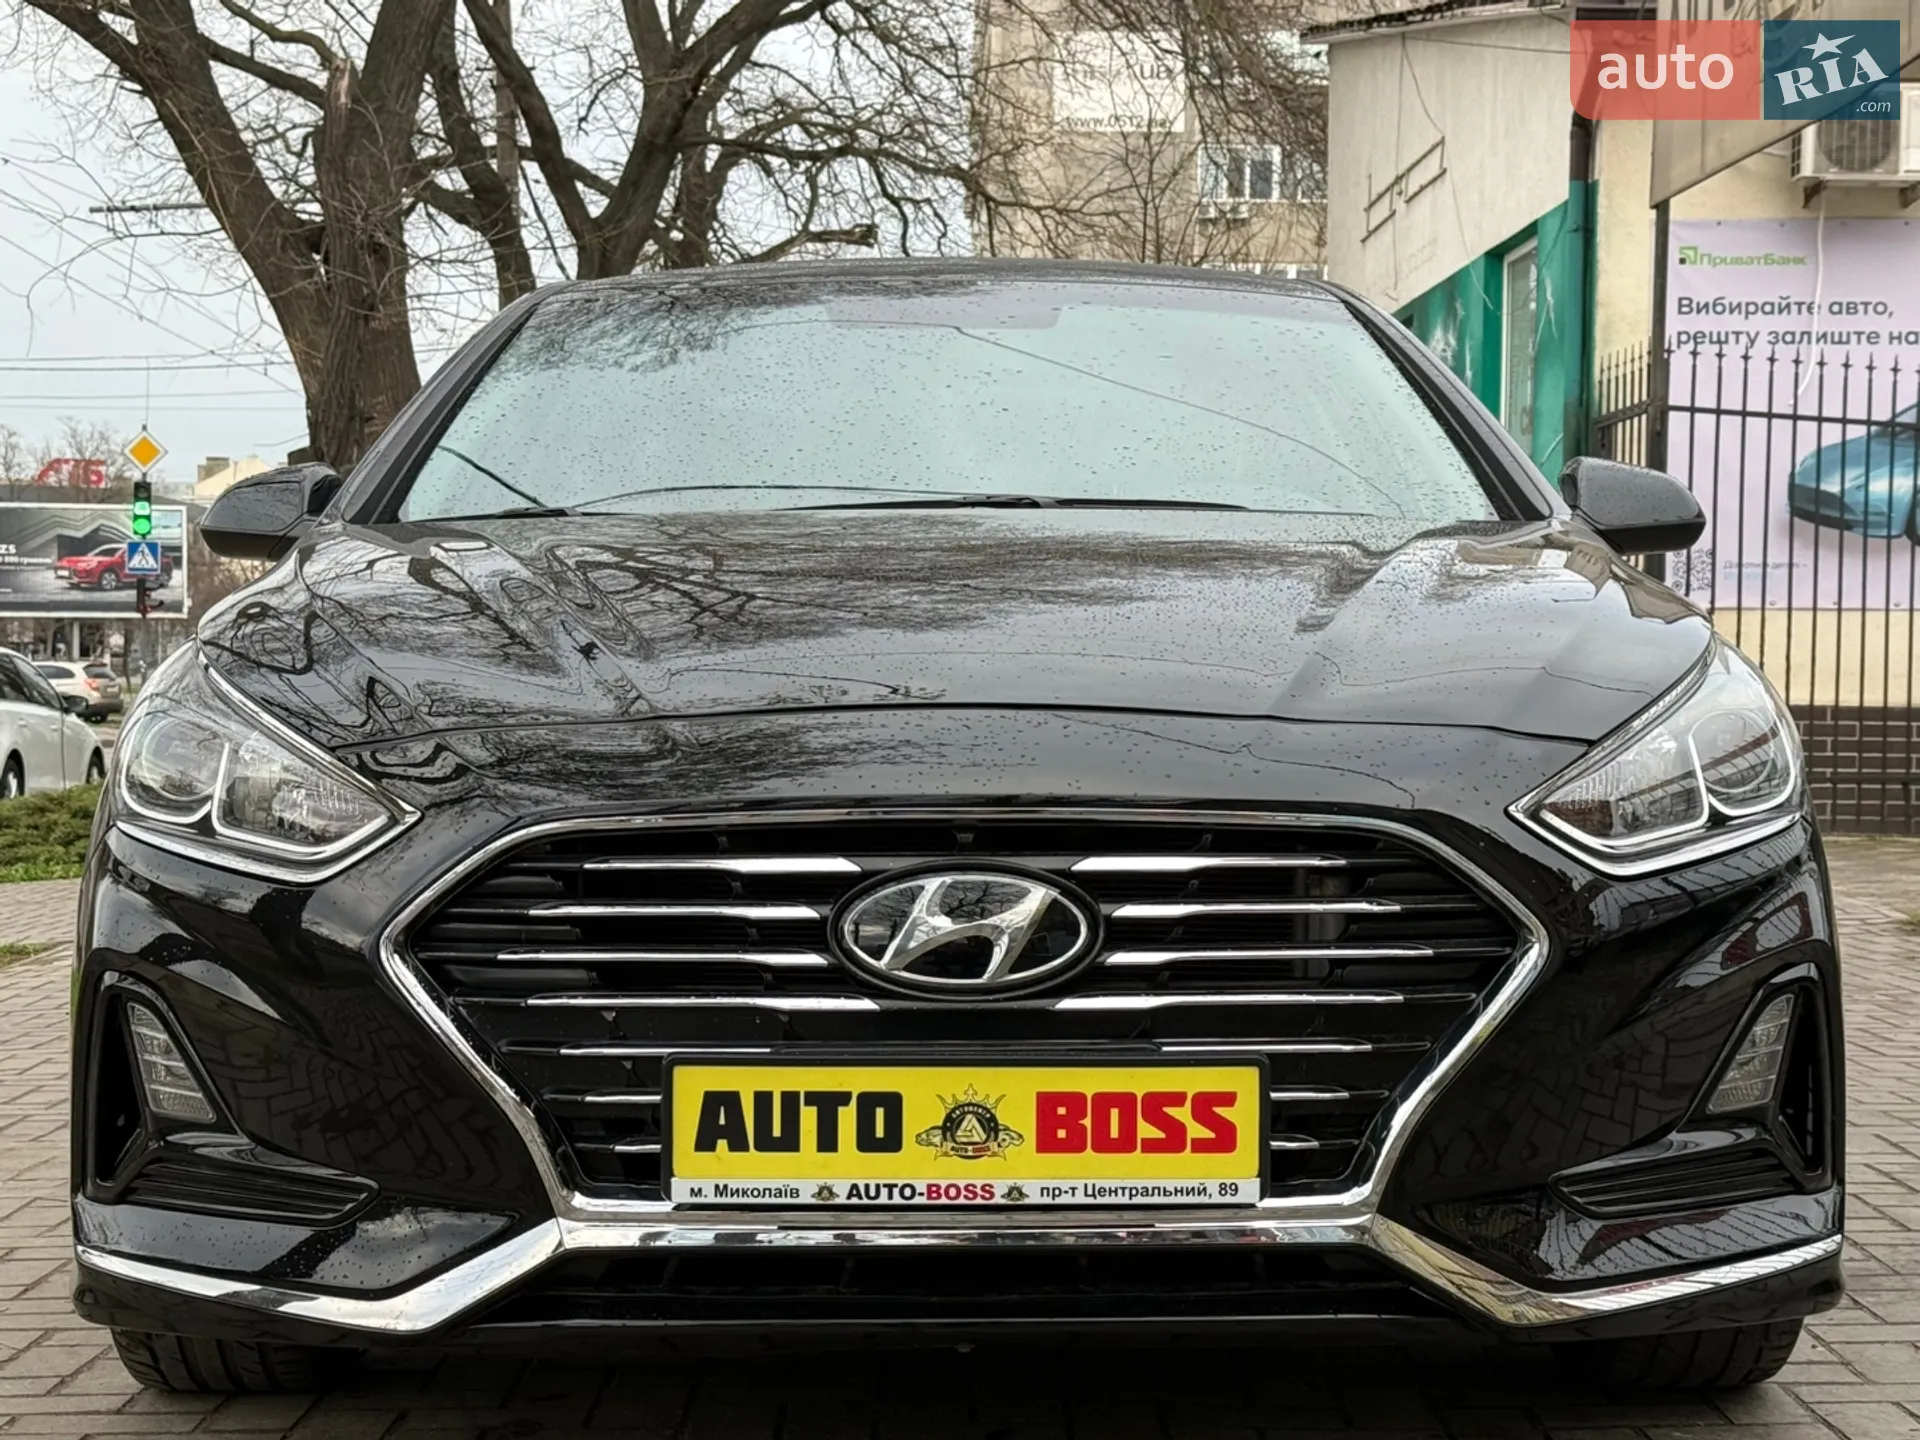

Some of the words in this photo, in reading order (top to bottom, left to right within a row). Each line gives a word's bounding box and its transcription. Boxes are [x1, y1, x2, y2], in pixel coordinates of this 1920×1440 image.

[1699, 252, 1807, 267] ПриватБанк
[1677, 295, 1822, 320] Вибирайте
[1828, 301, 1893, 318] авто,
[1676, 330, 1760, 349] решту
[1767, 330, 1881, 345] залиште
[1888, 331, 1920, 345] на
[694, 1090, 903, 1153] AUTO
[1036, 1091, 1237, 1154] BOSS
[689, 1187, 708, 1198] м.
[714, 1184, 800, 1199] Миколаїв
[846, 1183, 995, 1201] AUTO-BOSS
[1040, 1186, 1078, 1200] пр-т
[1083, 1182, 1212, 1200] Центральний,
[1218, 1182, 1239, 1196] 89
